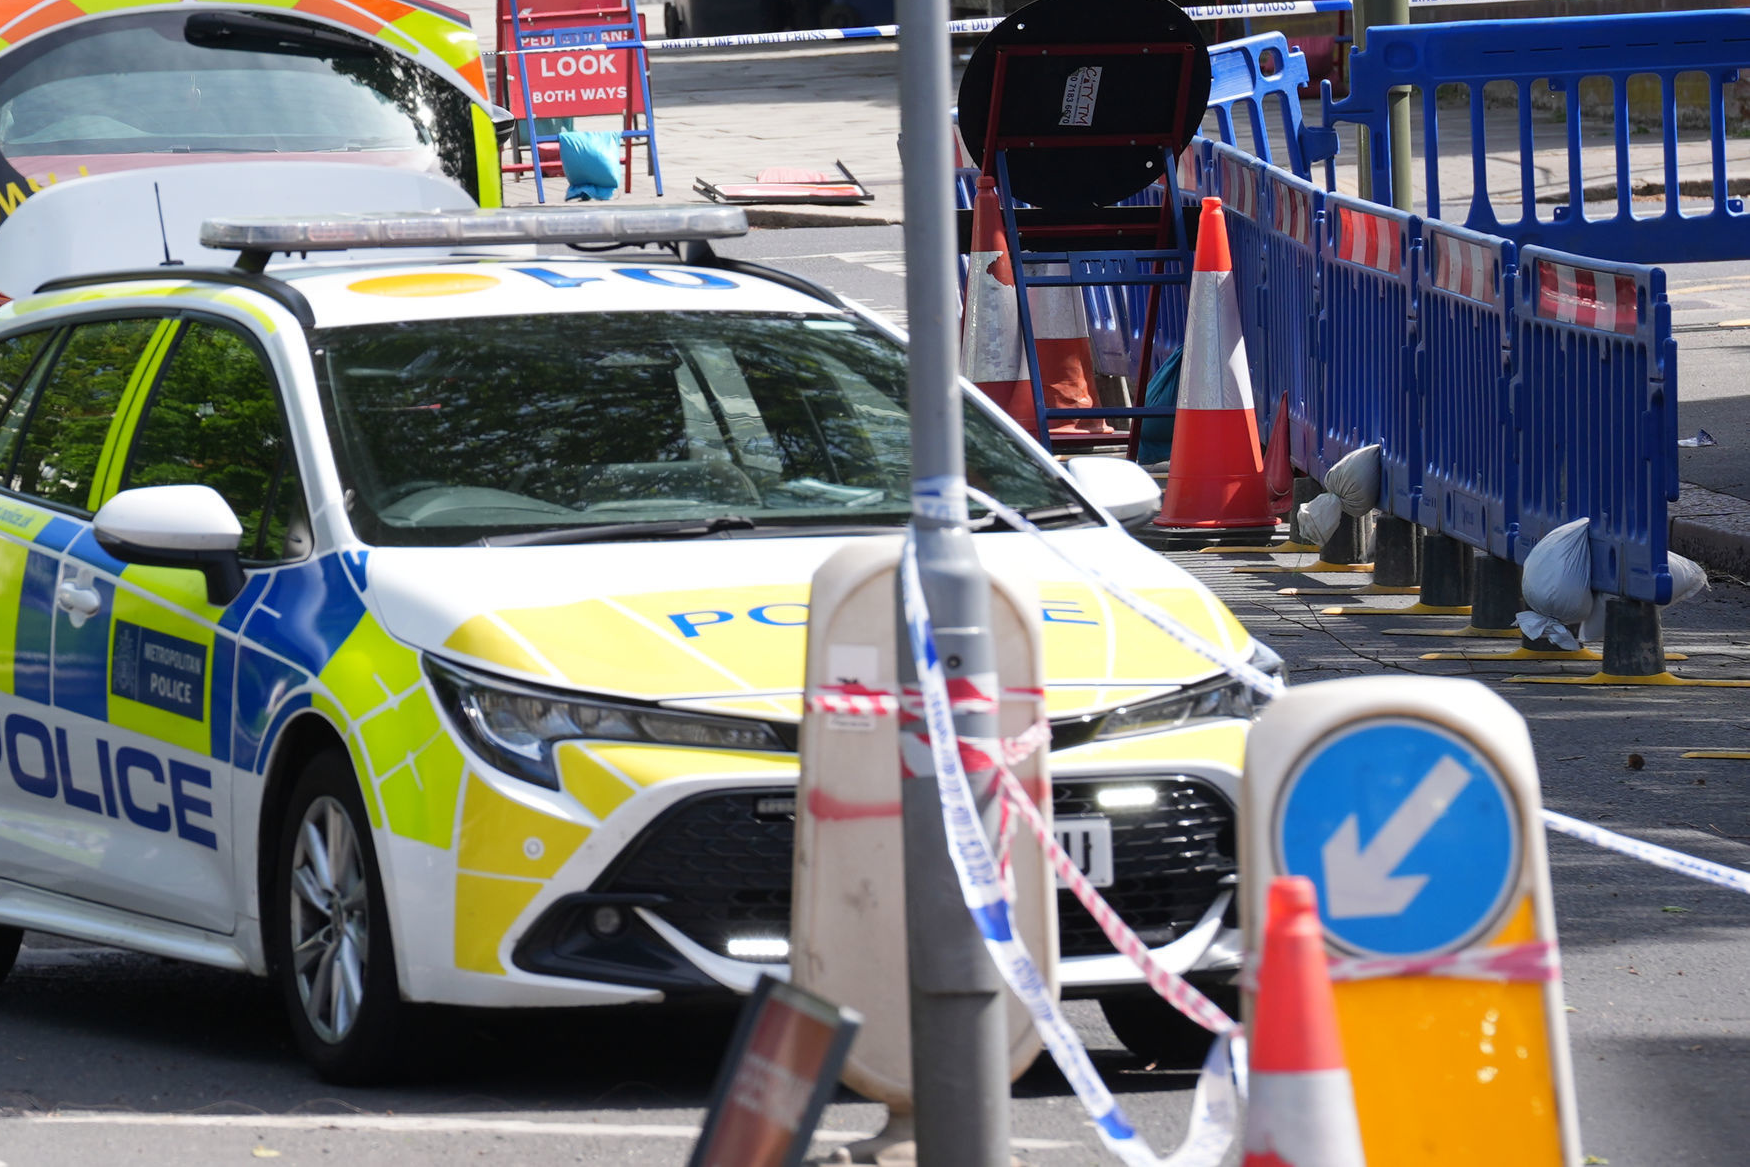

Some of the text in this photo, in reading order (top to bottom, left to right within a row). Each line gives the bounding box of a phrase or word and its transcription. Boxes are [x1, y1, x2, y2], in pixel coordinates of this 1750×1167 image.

[785, 30, 827, 42] CROSS
[948, 20, 968, 32] INE
[540, 54, 617, 78] LOOK
[532, 86, 628, 104] BOTH WAYS
[144, 642, 202, 676] METROPOLITAN
[149, 672, 193, 704] POLICE
